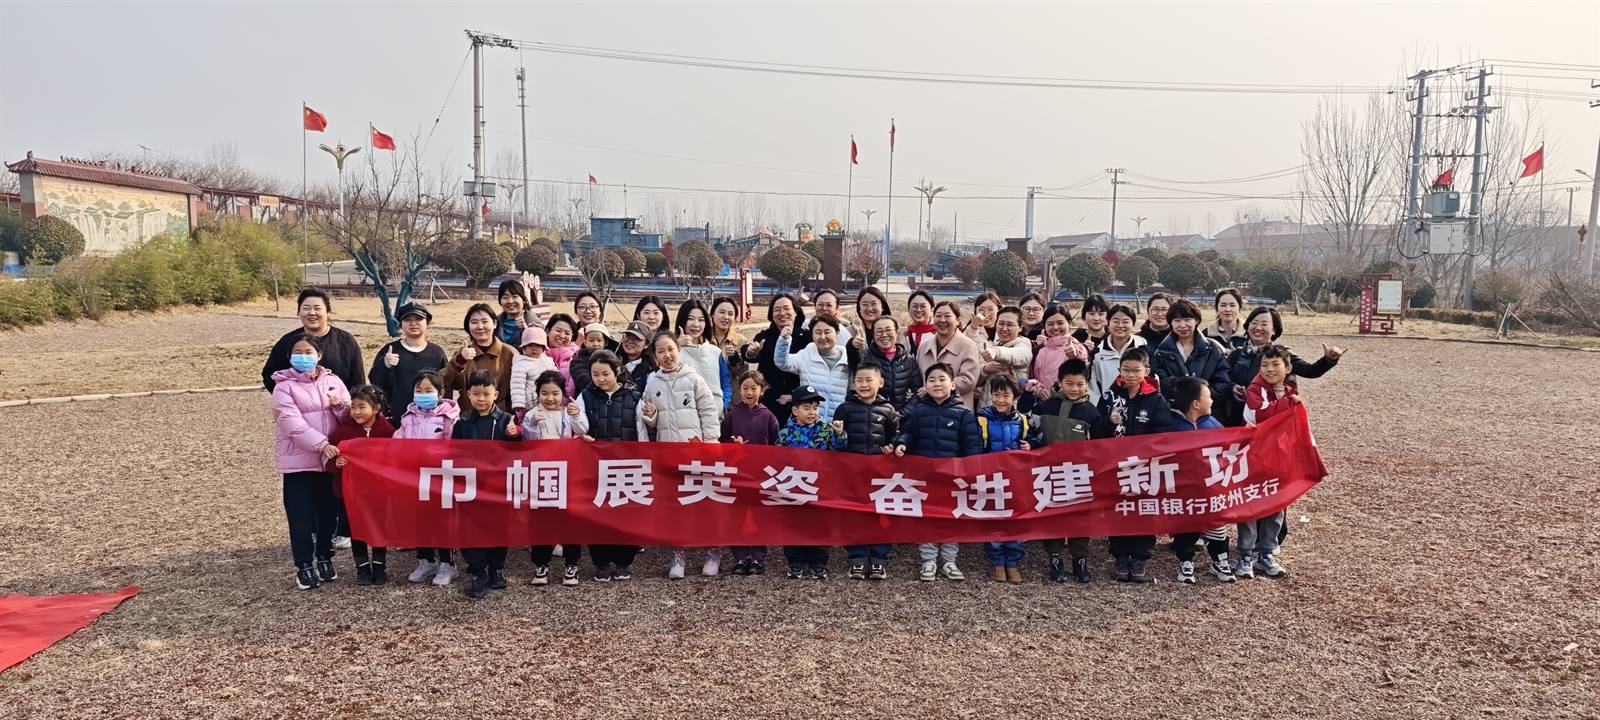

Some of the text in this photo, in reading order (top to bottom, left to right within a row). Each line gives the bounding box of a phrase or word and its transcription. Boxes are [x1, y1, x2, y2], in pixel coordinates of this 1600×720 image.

[418, 442, 1250, 518] 巾帼展英姿 奋进建新功
[1115, 478, 1279, 516] 中国银行胶州支行
